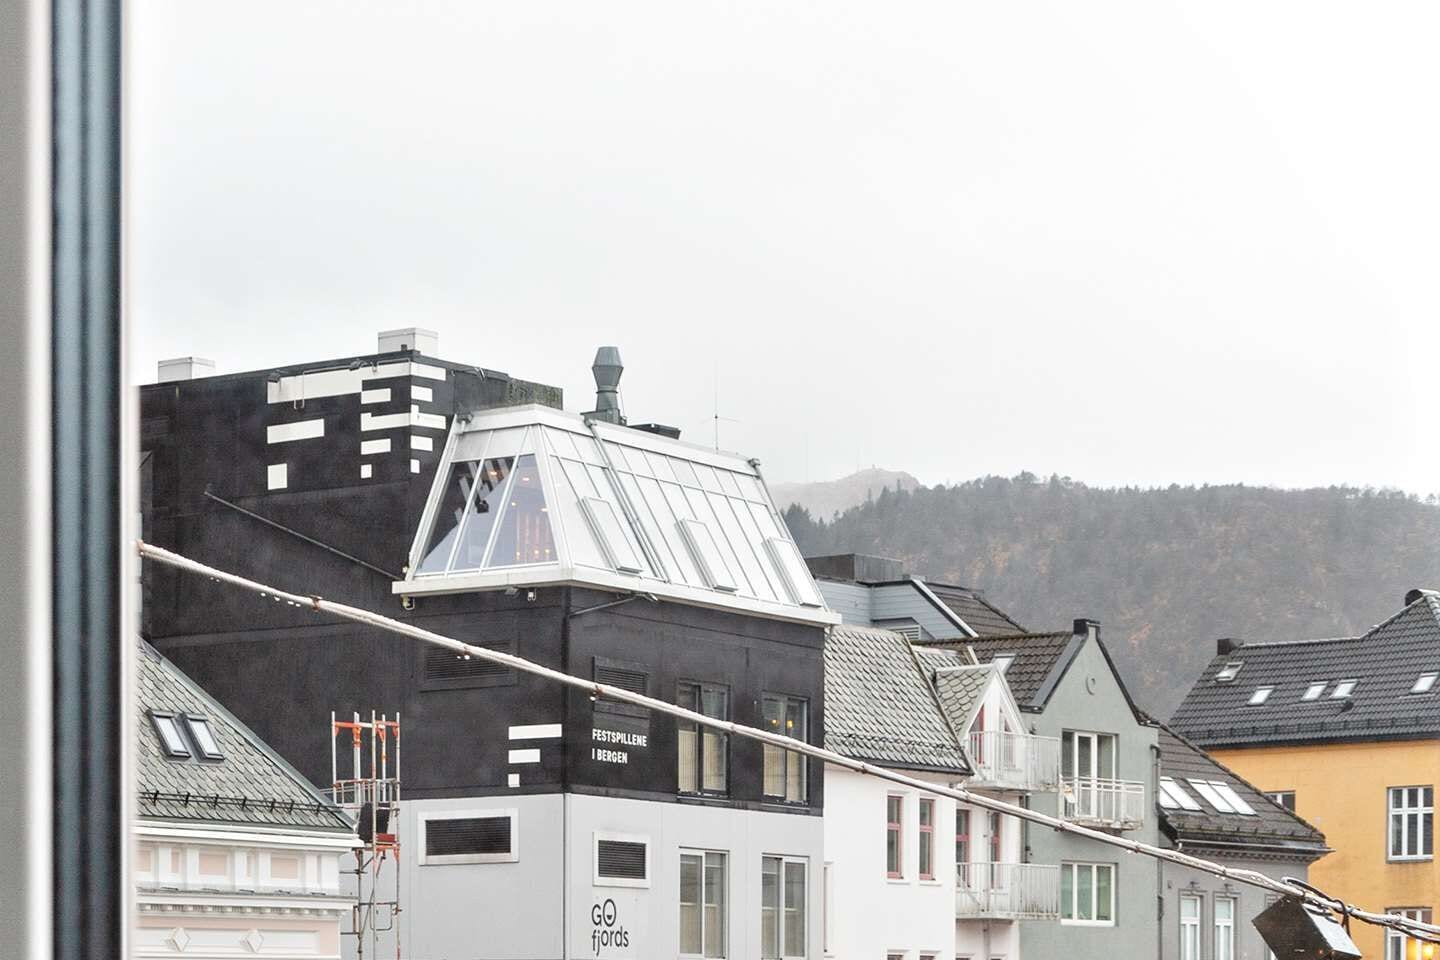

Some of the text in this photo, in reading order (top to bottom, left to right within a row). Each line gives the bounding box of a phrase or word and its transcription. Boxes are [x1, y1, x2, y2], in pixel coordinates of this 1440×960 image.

[592, 728, 648, 747] FESTSPILLENE
[597, 748, 628, 764] BERGEN
[591, 898, 617, 927] GO
[591, 925, 630, 957] fjords
